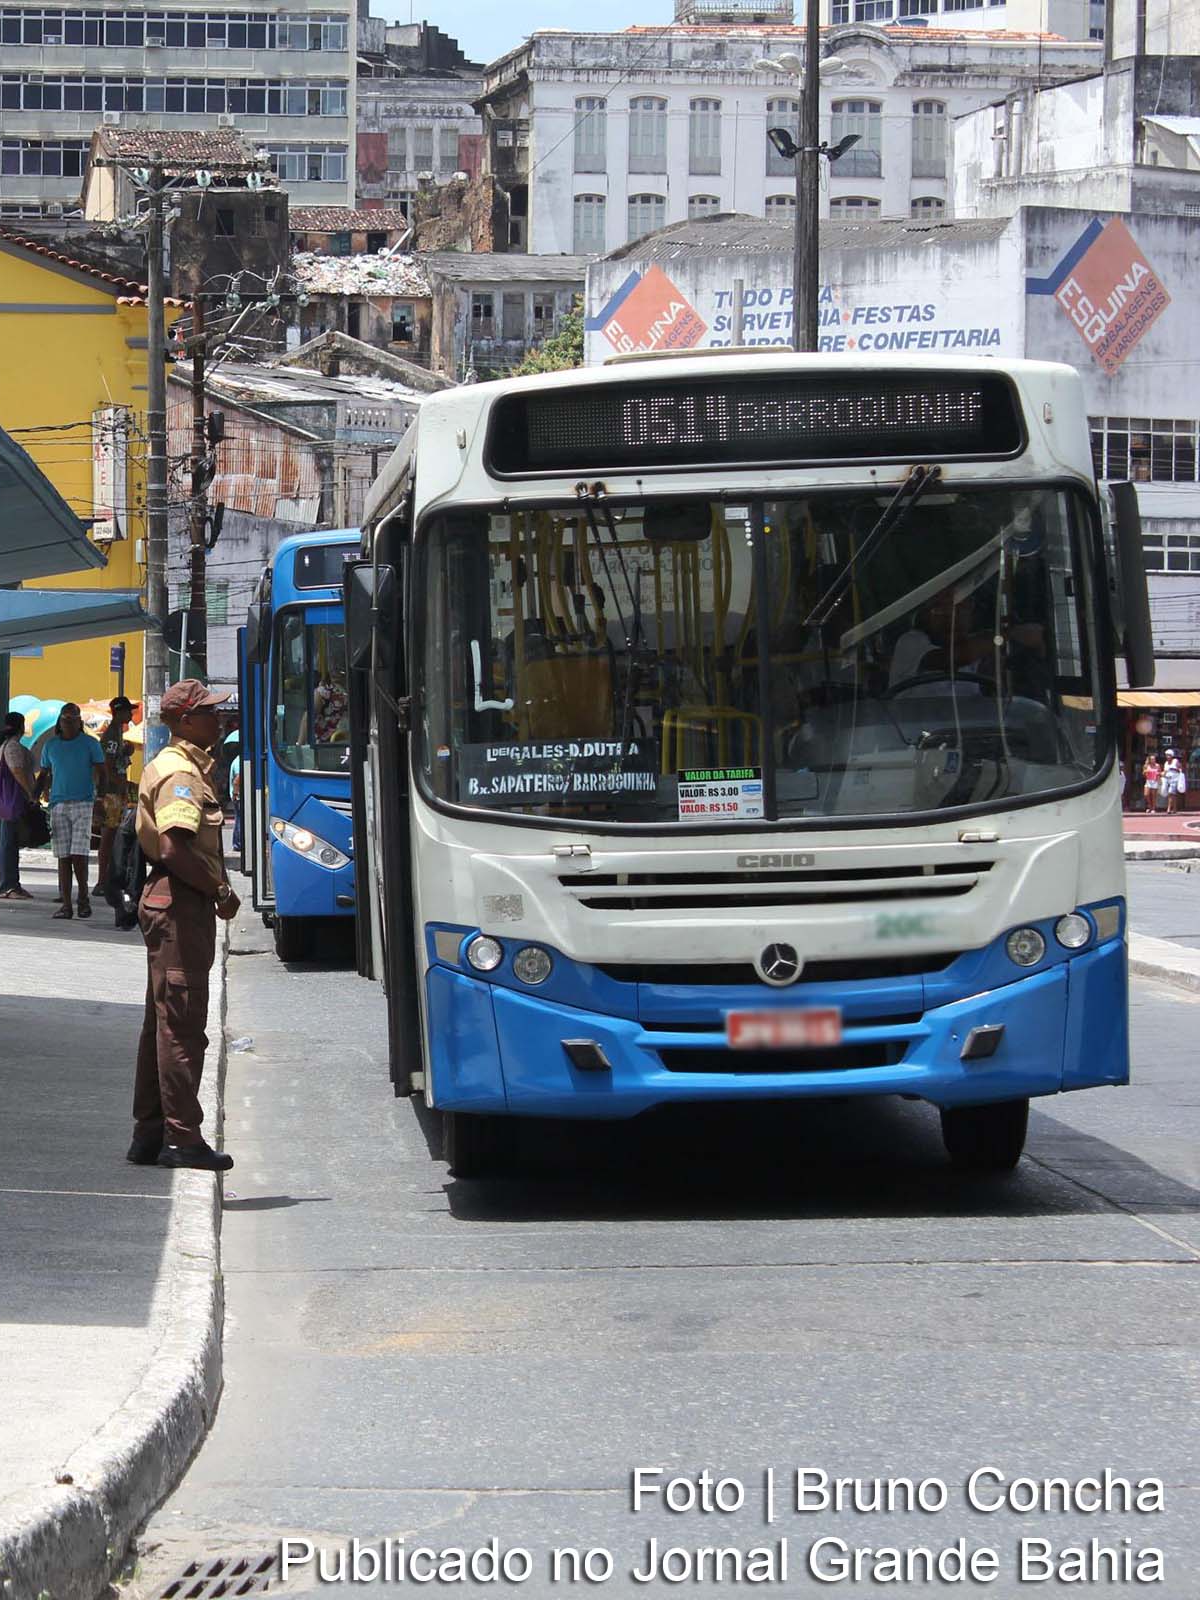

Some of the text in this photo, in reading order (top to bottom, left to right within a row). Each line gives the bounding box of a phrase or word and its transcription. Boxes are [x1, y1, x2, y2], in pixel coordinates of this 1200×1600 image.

[852, 304, 936, 325] FESTAS
[858, 328, 1001, 351] CONFEITARIA
[623, 395, 730, 445] 0514
[685, 768, 754, 780] VALOR DA TARIFA
[679, 788, 707, 798] VALOR:
[720, 786, 739, 796] 3,00
[680, 803, 708, 813] VALOR:
[736, 853, 815, 868] CAIO
